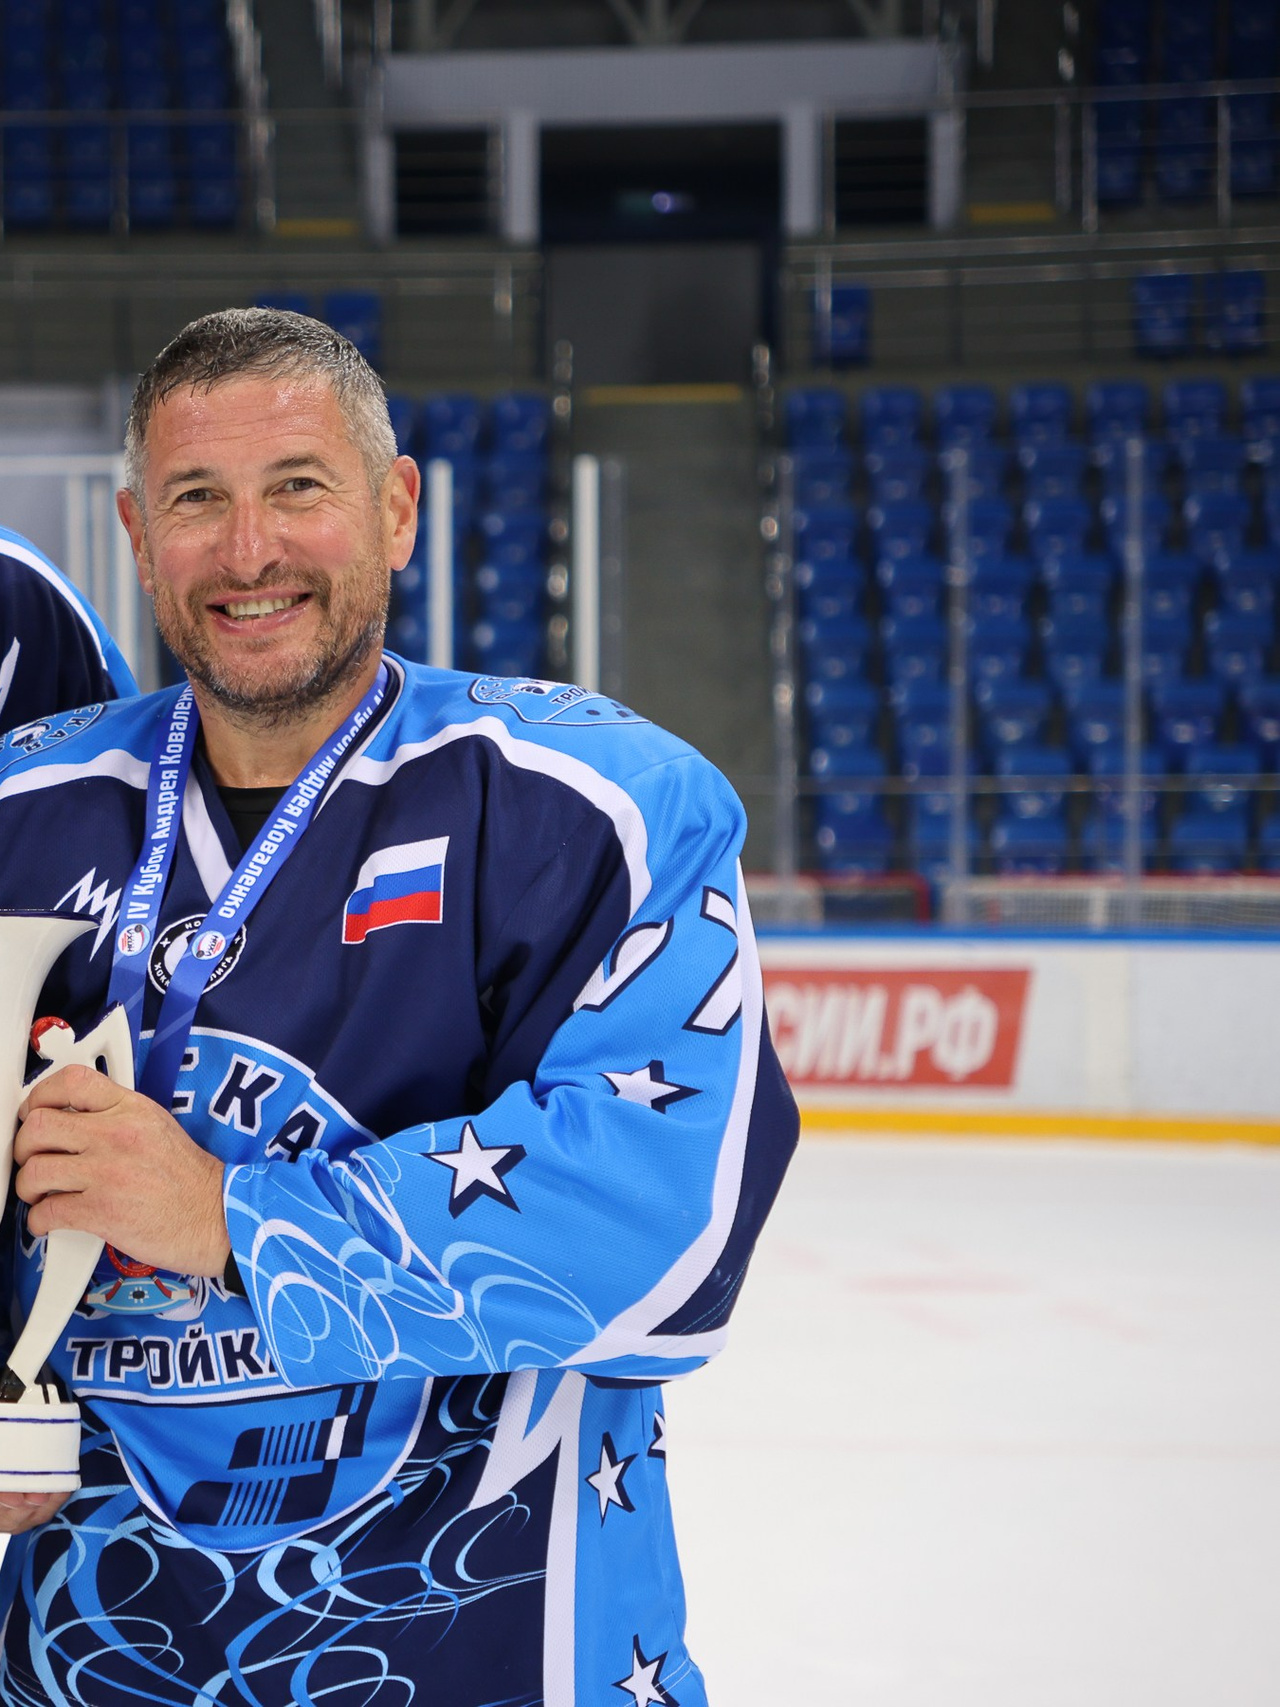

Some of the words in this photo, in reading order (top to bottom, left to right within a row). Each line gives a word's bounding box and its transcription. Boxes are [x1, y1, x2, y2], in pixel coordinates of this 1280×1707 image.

[158, 684, 195, 766] Ковален
[151, 769, 180, 840] Андрея
[131, 843, 168, 896] Кубок
[218, 817, 298, 919] Коваленко
[126, 901, 151, 920] IV
